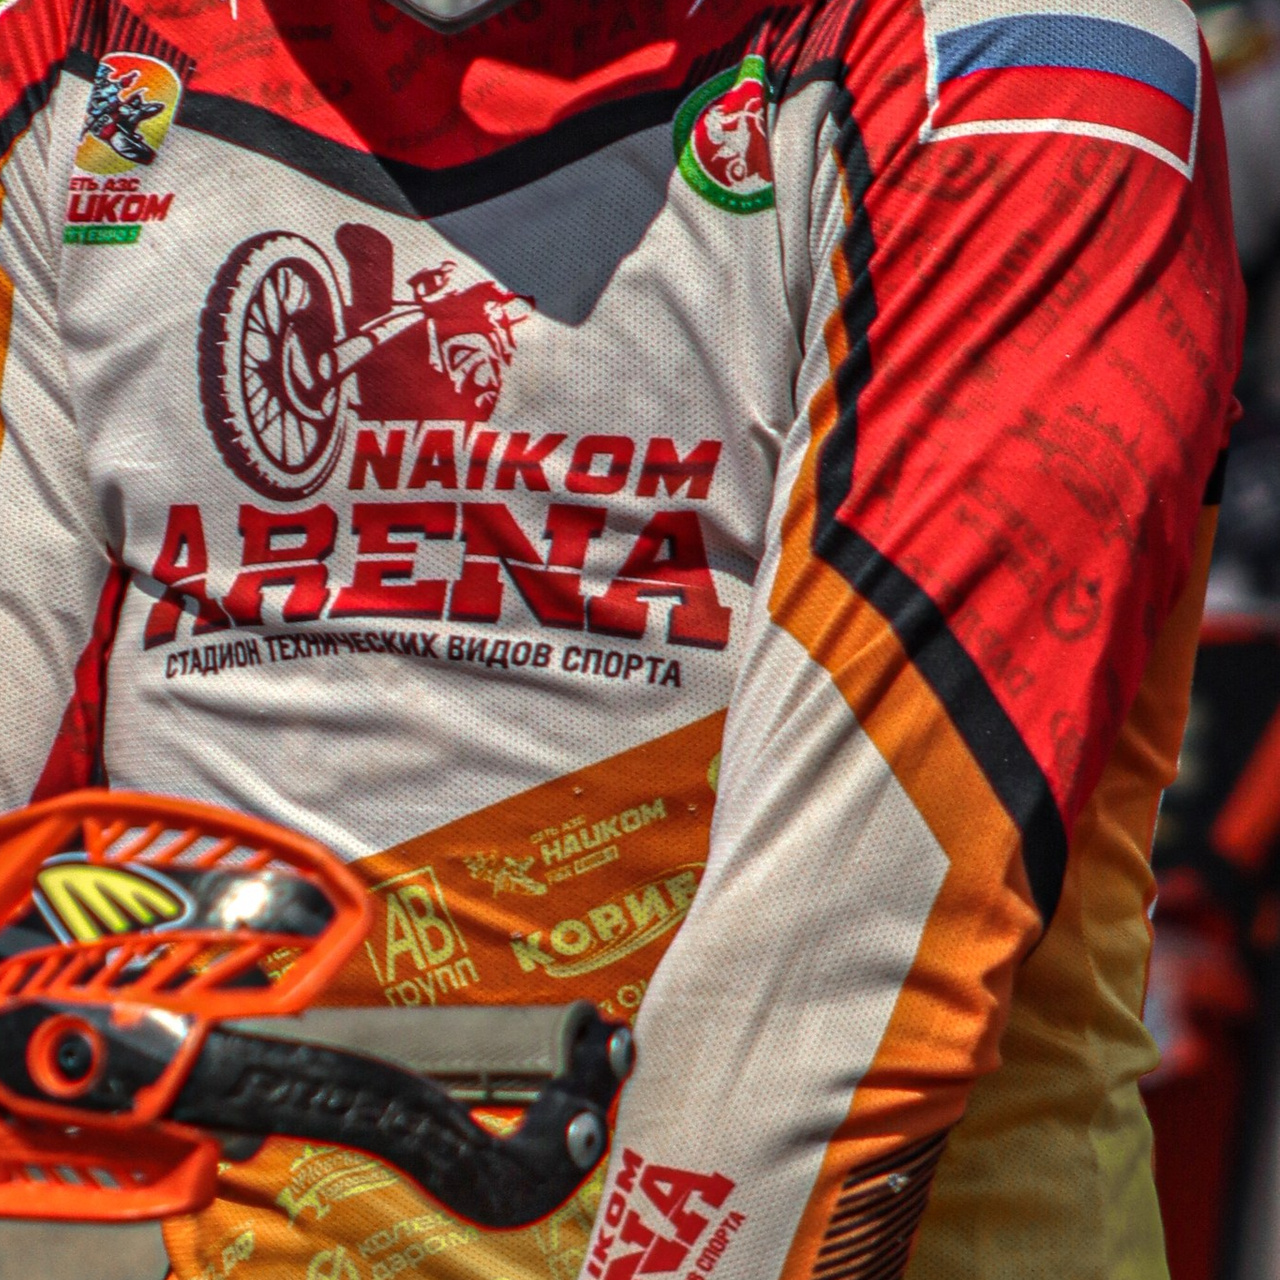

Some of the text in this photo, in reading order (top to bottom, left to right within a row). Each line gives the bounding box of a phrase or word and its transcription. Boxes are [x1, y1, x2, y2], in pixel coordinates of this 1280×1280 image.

[348, 426, 723, 501] NAIKOM
[144, 501, 733, 652] ARENA
[165, 631, 683, 689] СТАДИОН ТЕХНИЧЕСКИХ ВИДОВ СПОРТА
[696, 1210, 748, 1273] СПОРТА
